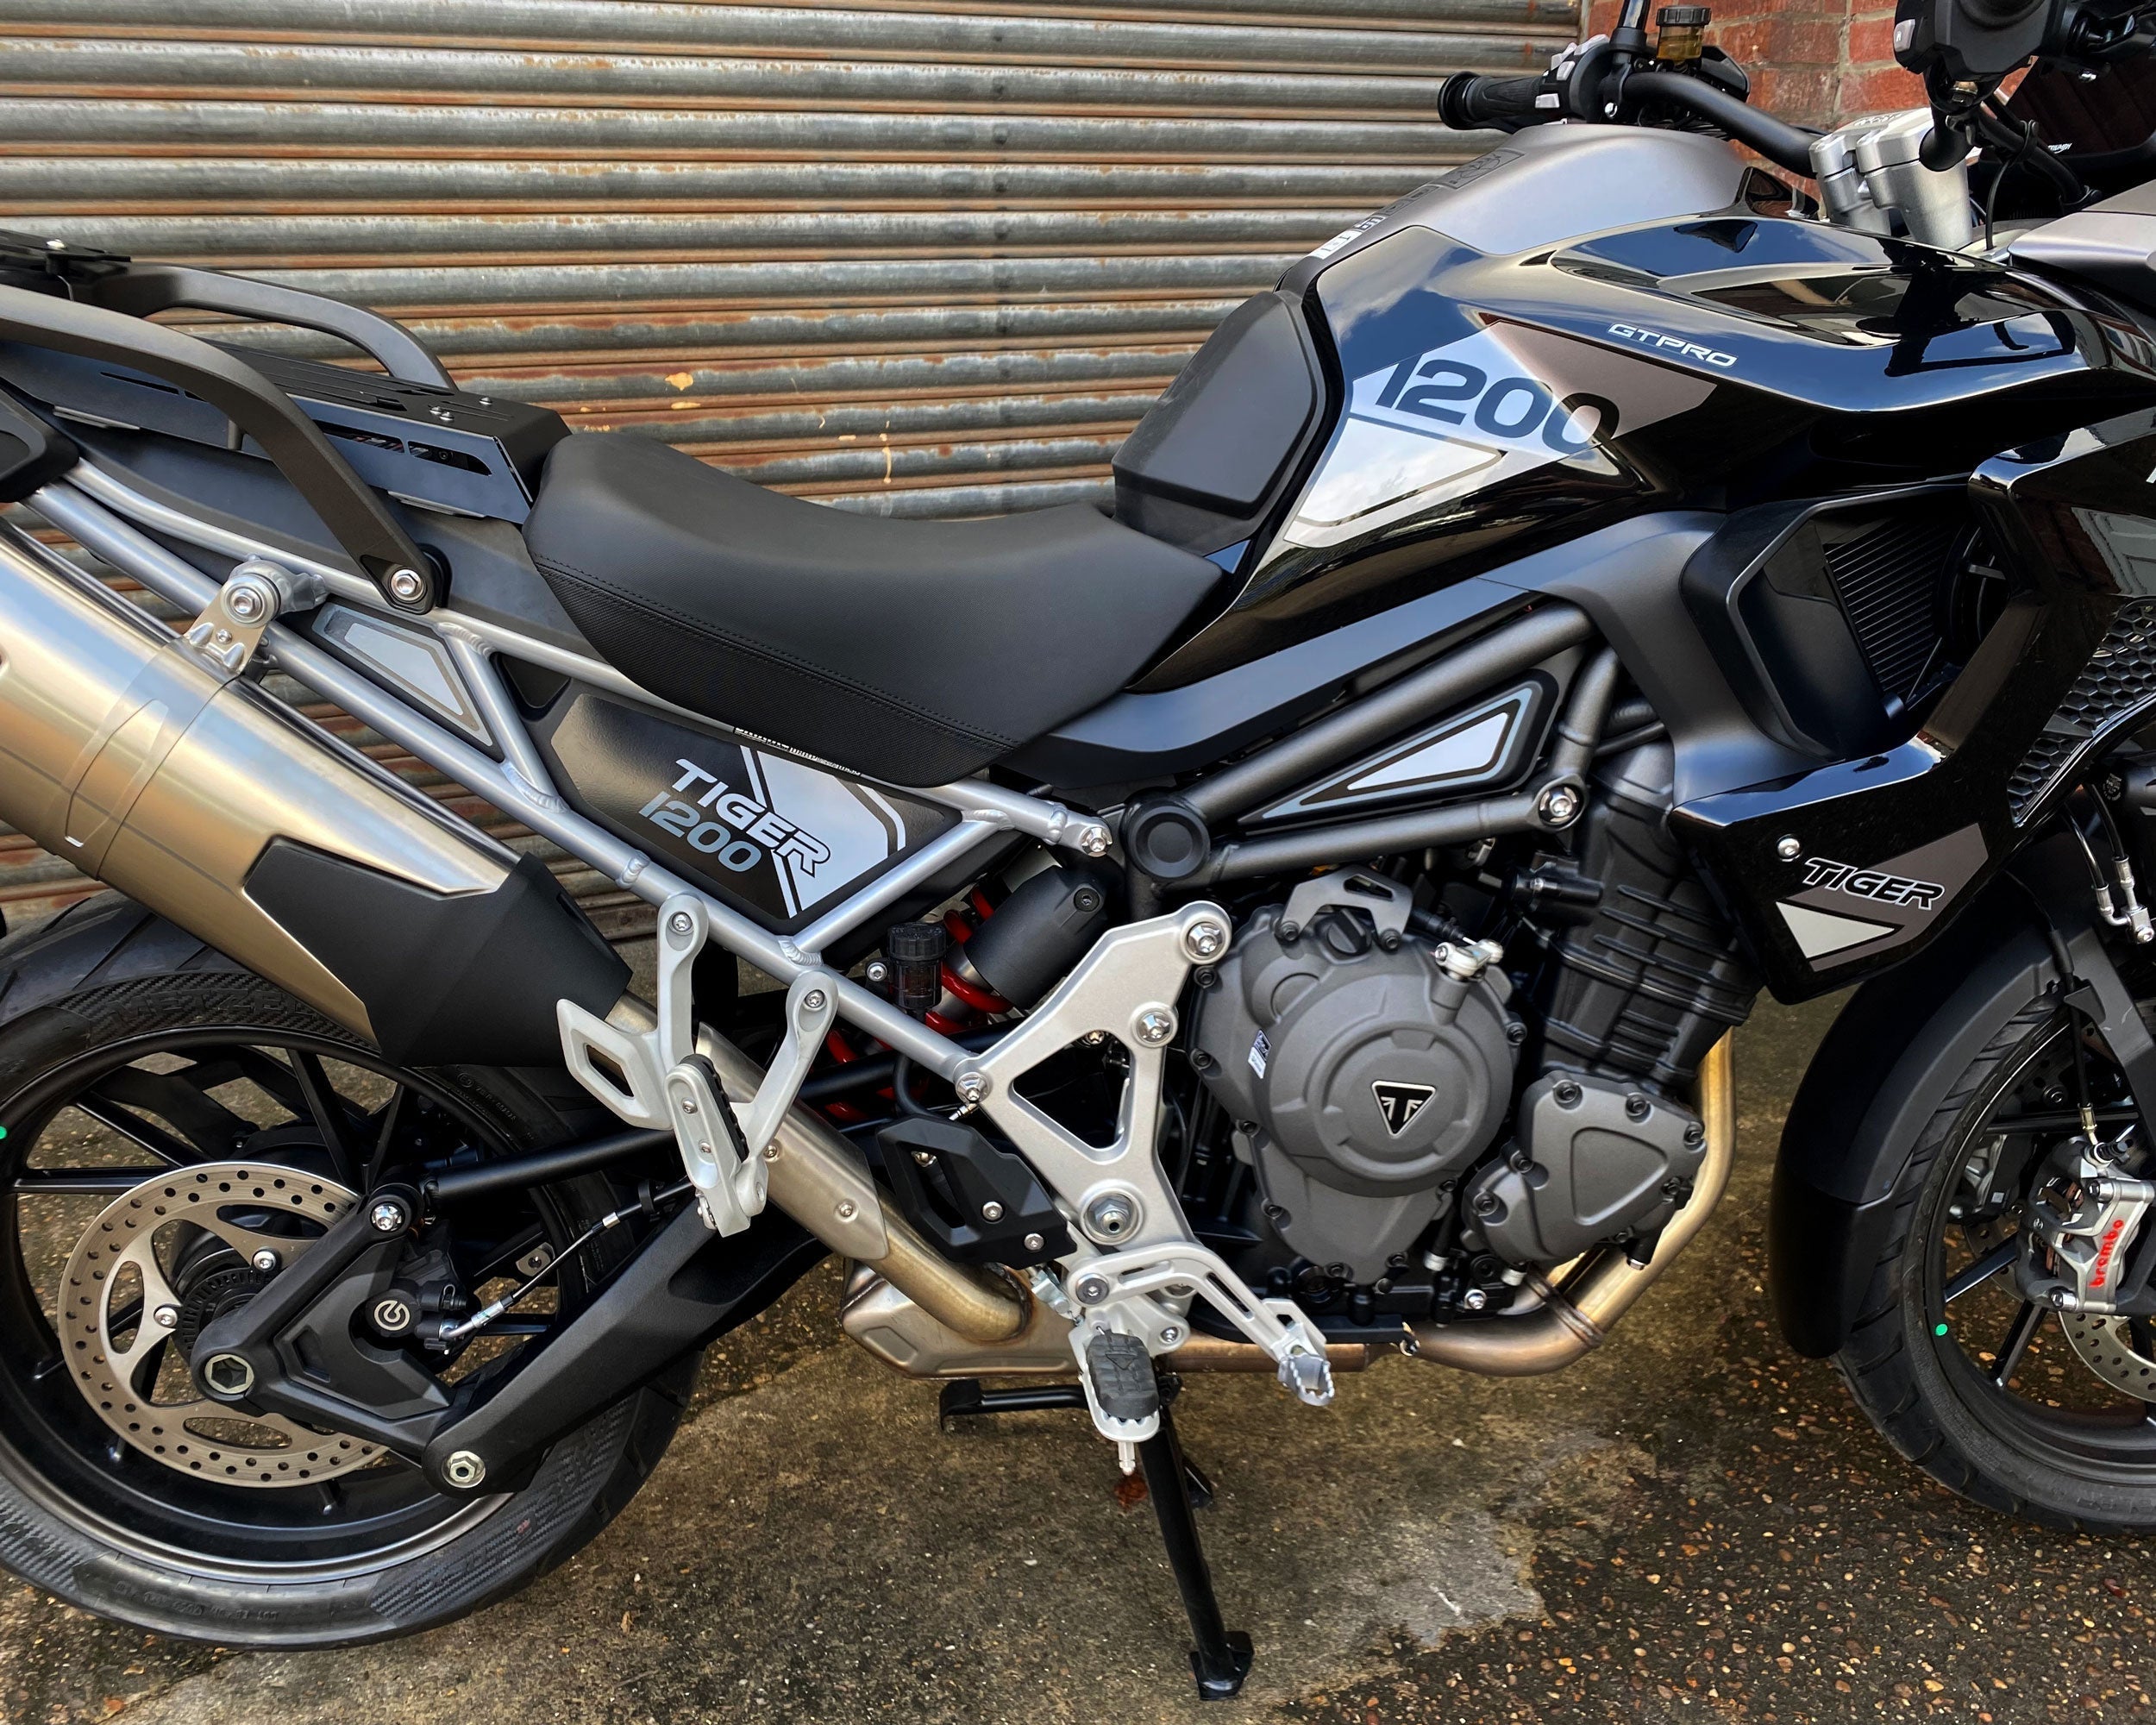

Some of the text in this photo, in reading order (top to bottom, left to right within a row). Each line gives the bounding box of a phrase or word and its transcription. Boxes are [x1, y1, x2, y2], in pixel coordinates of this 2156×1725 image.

[1375, 354, 1620, 455] 1200
[637, 791, 762, 873] 1200
[674, 757, 831, 878] TIGER
[1802, 856, 1946, 911] TIGER
[2089, 1219, 2124, 1288] brembo
